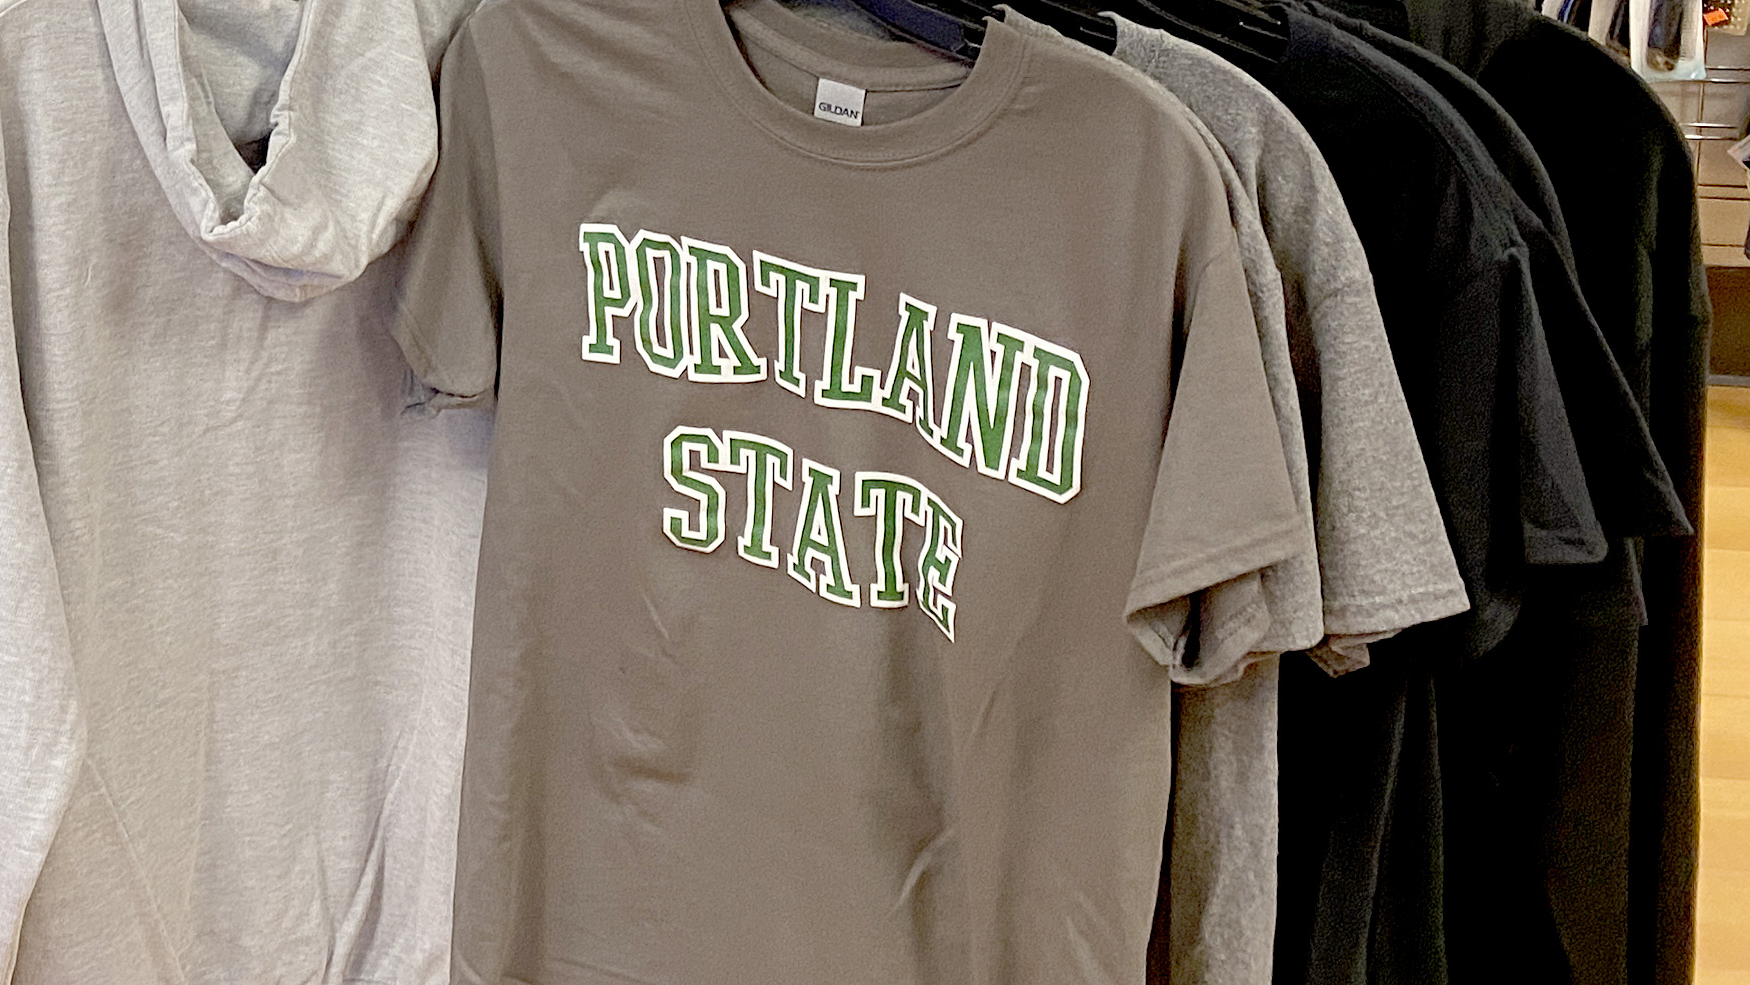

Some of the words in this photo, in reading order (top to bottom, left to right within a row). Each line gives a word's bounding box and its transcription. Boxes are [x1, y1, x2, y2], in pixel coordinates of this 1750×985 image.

[818, 101, 860, 120] GILDAN
[580, 223, 1090, 503] PORTLAND
[663, 425, 962, 642] STATE
